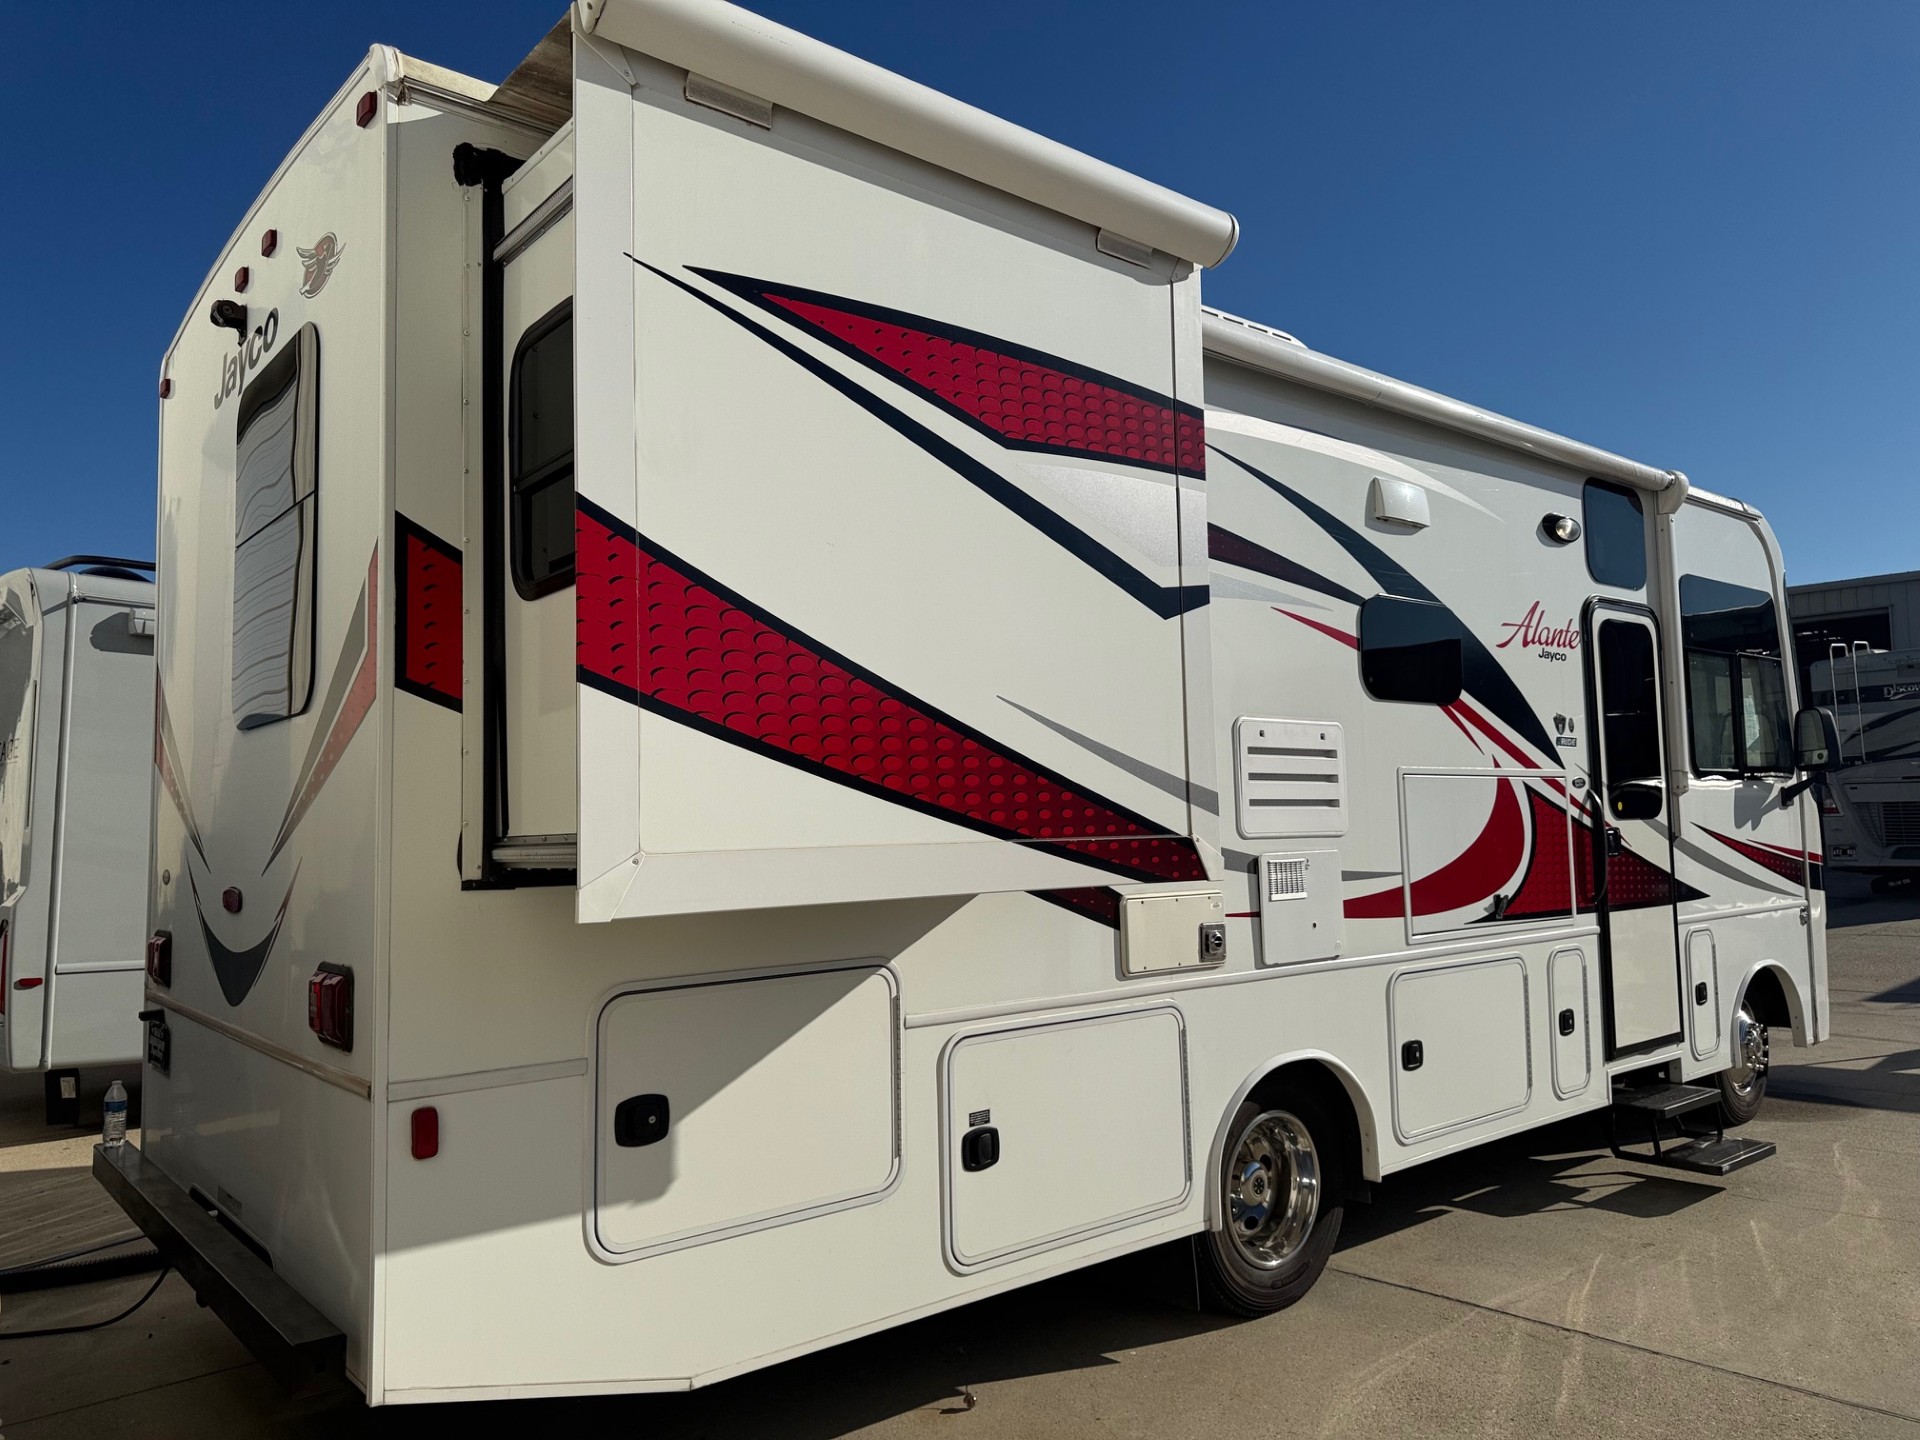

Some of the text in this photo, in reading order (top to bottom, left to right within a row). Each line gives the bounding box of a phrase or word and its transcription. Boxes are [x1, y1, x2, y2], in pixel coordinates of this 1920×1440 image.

[213, 306, 279, 410] Jayco
[1495, 600, 1581, 650] Alante
[1538, 647, 1567, 662] Jayco
[0, 737, 20, 761] AGE
